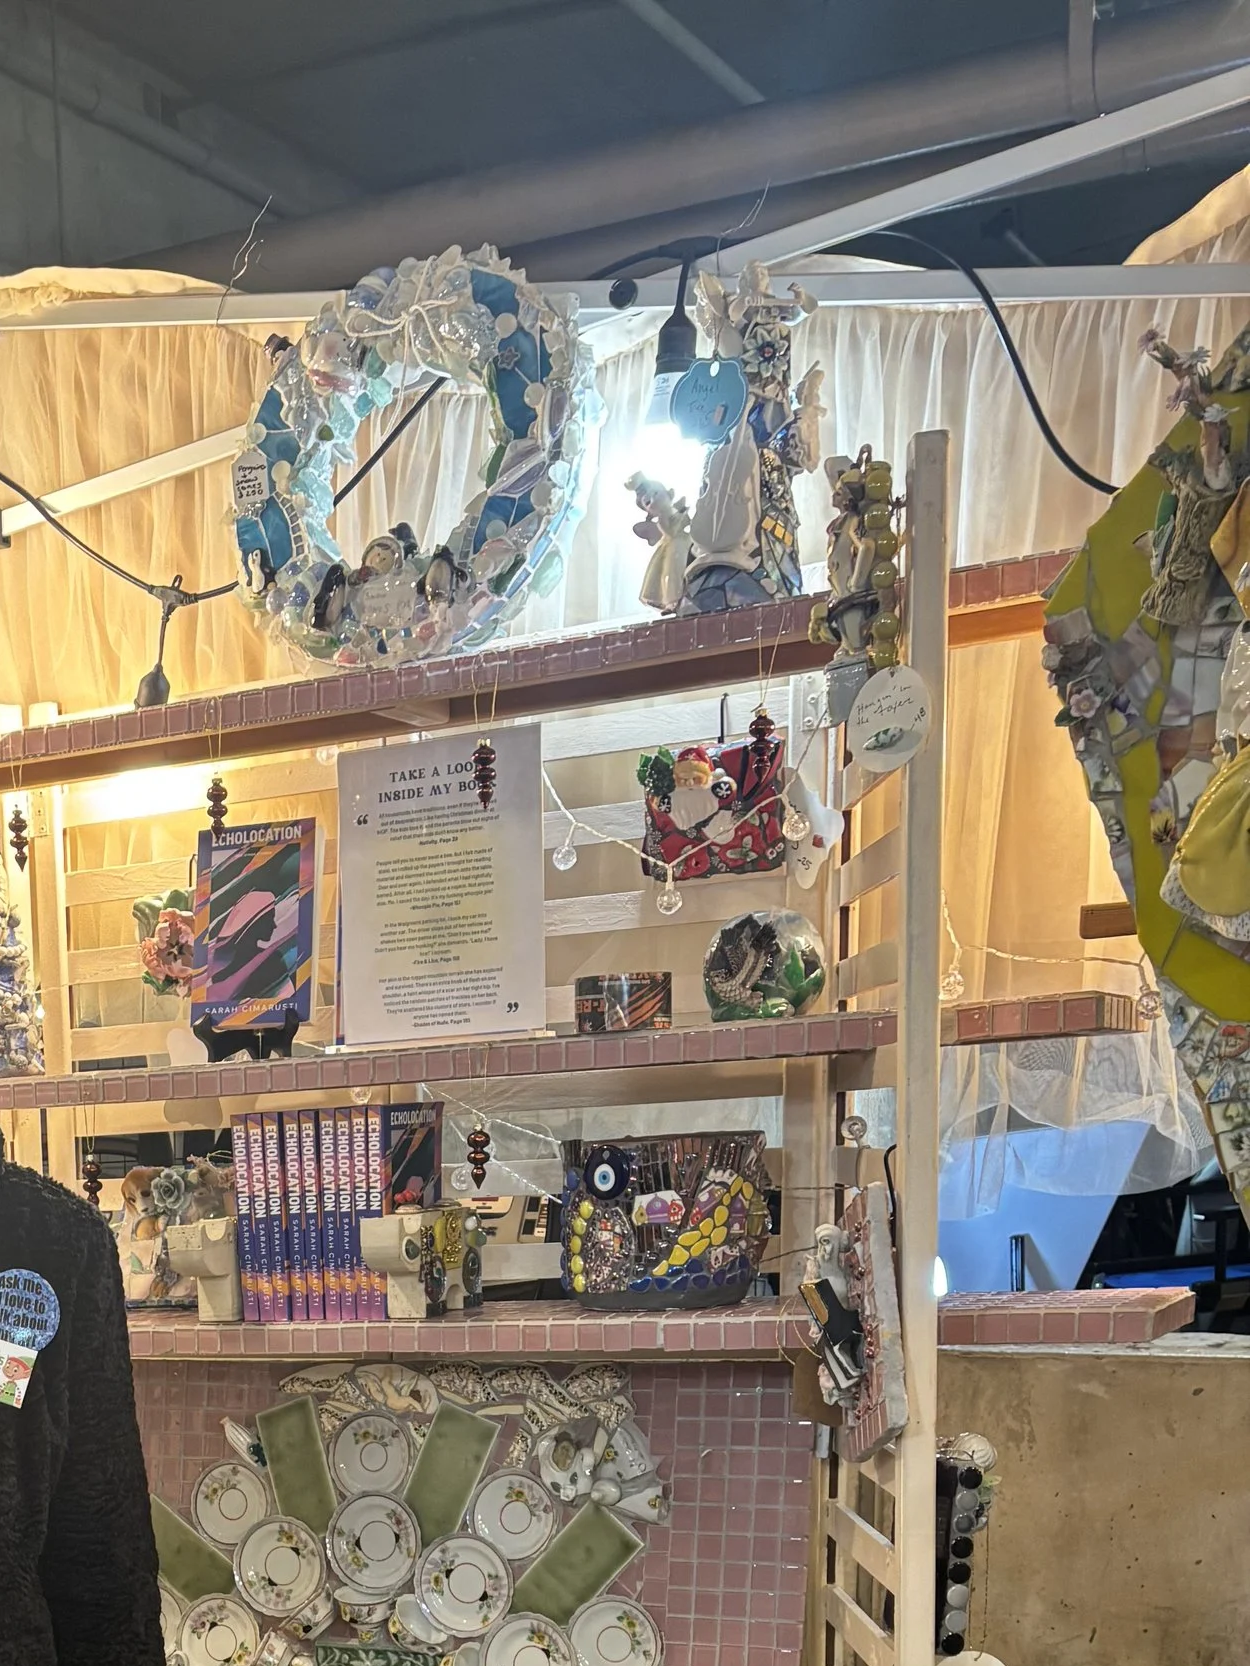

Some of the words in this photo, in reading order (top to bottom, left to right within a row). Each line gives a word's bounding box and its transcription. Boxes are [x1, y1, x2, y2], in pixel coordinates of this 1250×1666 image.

[378, 787, 424, 803] INSIDE
[430, 783, 452, 797] MY
[459, 779, 497, 792] BO
[389, 768, 426, 783] TAKE
[431, 766, 440, 777] A
[212, 825, 302, 847] ECHOLOCATION
[205, 1006, 238, 1015] SARAH
[242, 1003, 298, 1013] CIMARUSTI
[390, 1109, 436, 1125] ECHOLOCATION
[233, 1125, 250, 1214] ECHOLOCATION
[302, 1123, 317, 1214] ECHOLOCATION
[321, 1120, 335, 1211] ECHOLOCATION
[338, 1121, 350, 1212] ECHOLOCATION
[354, 1118, 367, 1210] ECHOLOCATION
[368, 1118, 381, 1210] ECHOLOCATION
[242, 1220, 250, 1251] SARAH
[250, 1128, 266, 1218] ECHOLOCATION
[261, 1259, 269, 1309] CIMARUSTI
[266, 1125, 280, 1215] ECHOLOCATION
[275, 1256, 283, 1307] CIMARUSTI
[286, 1124, 300, 1214] ECHOLOCATION
[294, 1255, 302, 1306] CIMARUSTI
[309, 1219, 317, 1251] SARAH
[5, 1291, 31, 1310] love
[34, 1299, 46, 1314] to
[245, 1254, 254, 1305] CIMARUSTI
[13, 1313, 48, 1330] about
